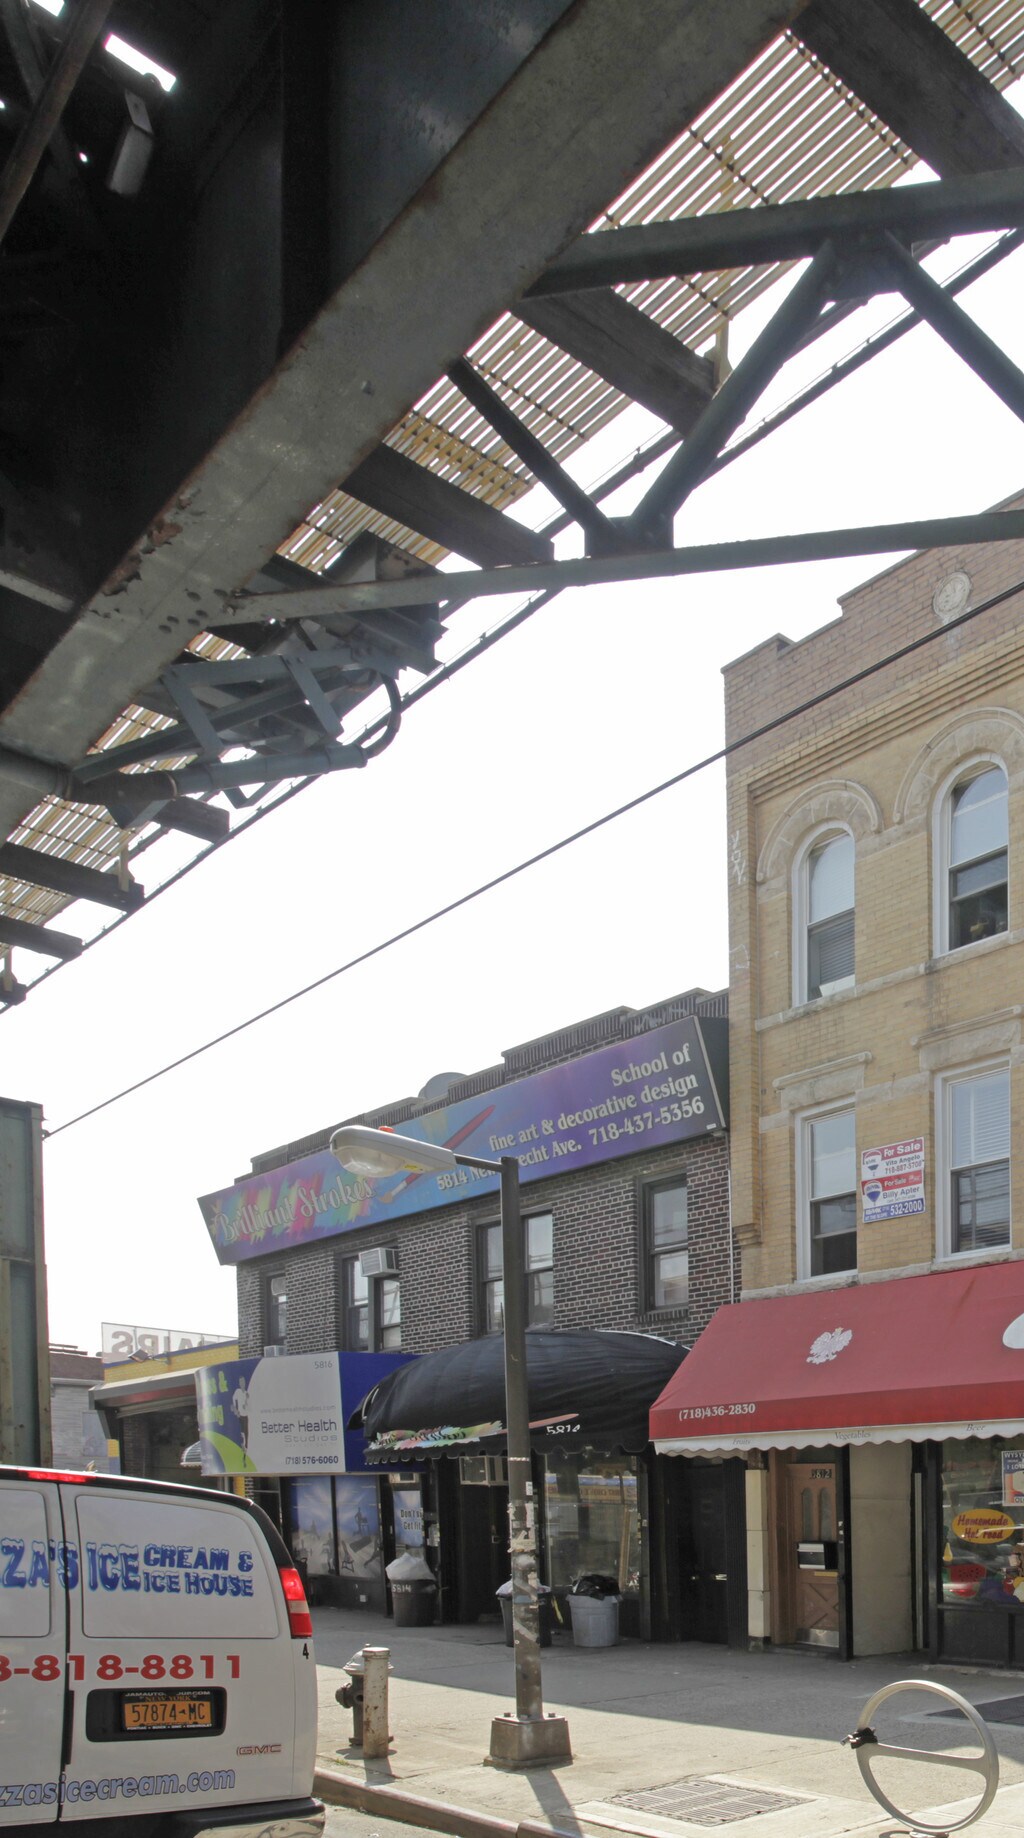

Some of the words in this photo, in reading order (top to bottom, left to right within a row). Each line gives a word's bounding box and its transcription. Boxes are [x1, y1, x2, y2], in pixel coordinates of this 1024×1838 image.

[610, 1051, 668, 1087] School
[672, 1043, 691, 1066] of
[489, 1134, 516, 1152] fine
[518, 1126, 540, 1143] art
[541, 1119, 555, 1135] &
[557, 1096, 637, 1131] decorative
[640, 1073, 699, 1105] design
[436, 1169, 468, 1190] 5814
[552, 1137, 582, 1160] Ave.
[588, 1096, 705, 1146] 718-437-5356
[883, 1149, 895, 1158] For
[896, 1142, 921, 1155] Sale
[213, 1198, 296, 1241] Brilliant
[299, 1175, 376, 1218] Strokes
[890, 1200, 922, 1216] 532-2000
[678, 1403, 756, 1421] (718)436-2830
[261, 1420, 295, 1434] Better
[298, 1418, 337, 1433] Health
[546, 1424, 581, 1436] 5814
[835, 1431, 872, 1442] Vegetables
[966, 1423, 986, 1432] Beer
[284, 1434, 338, 1443] Studios
[285, 1456, 301, 1465] (718)
[302, 1455, 339, 1465] 576-6060
[957, 1514, 1009, 1526] Homemade
[85, 1541, 141, 1592] ICE
[143, 1543, 230, 1571] CREAM
[238, 1550, 254, 1573] &
[143, 1570, 181, 1593] ICE
[185, 1571, 254, 1597] HOUSE
[302, 1643, 310, 1660] 4
[236, 1744, 282, 1756] GMC
